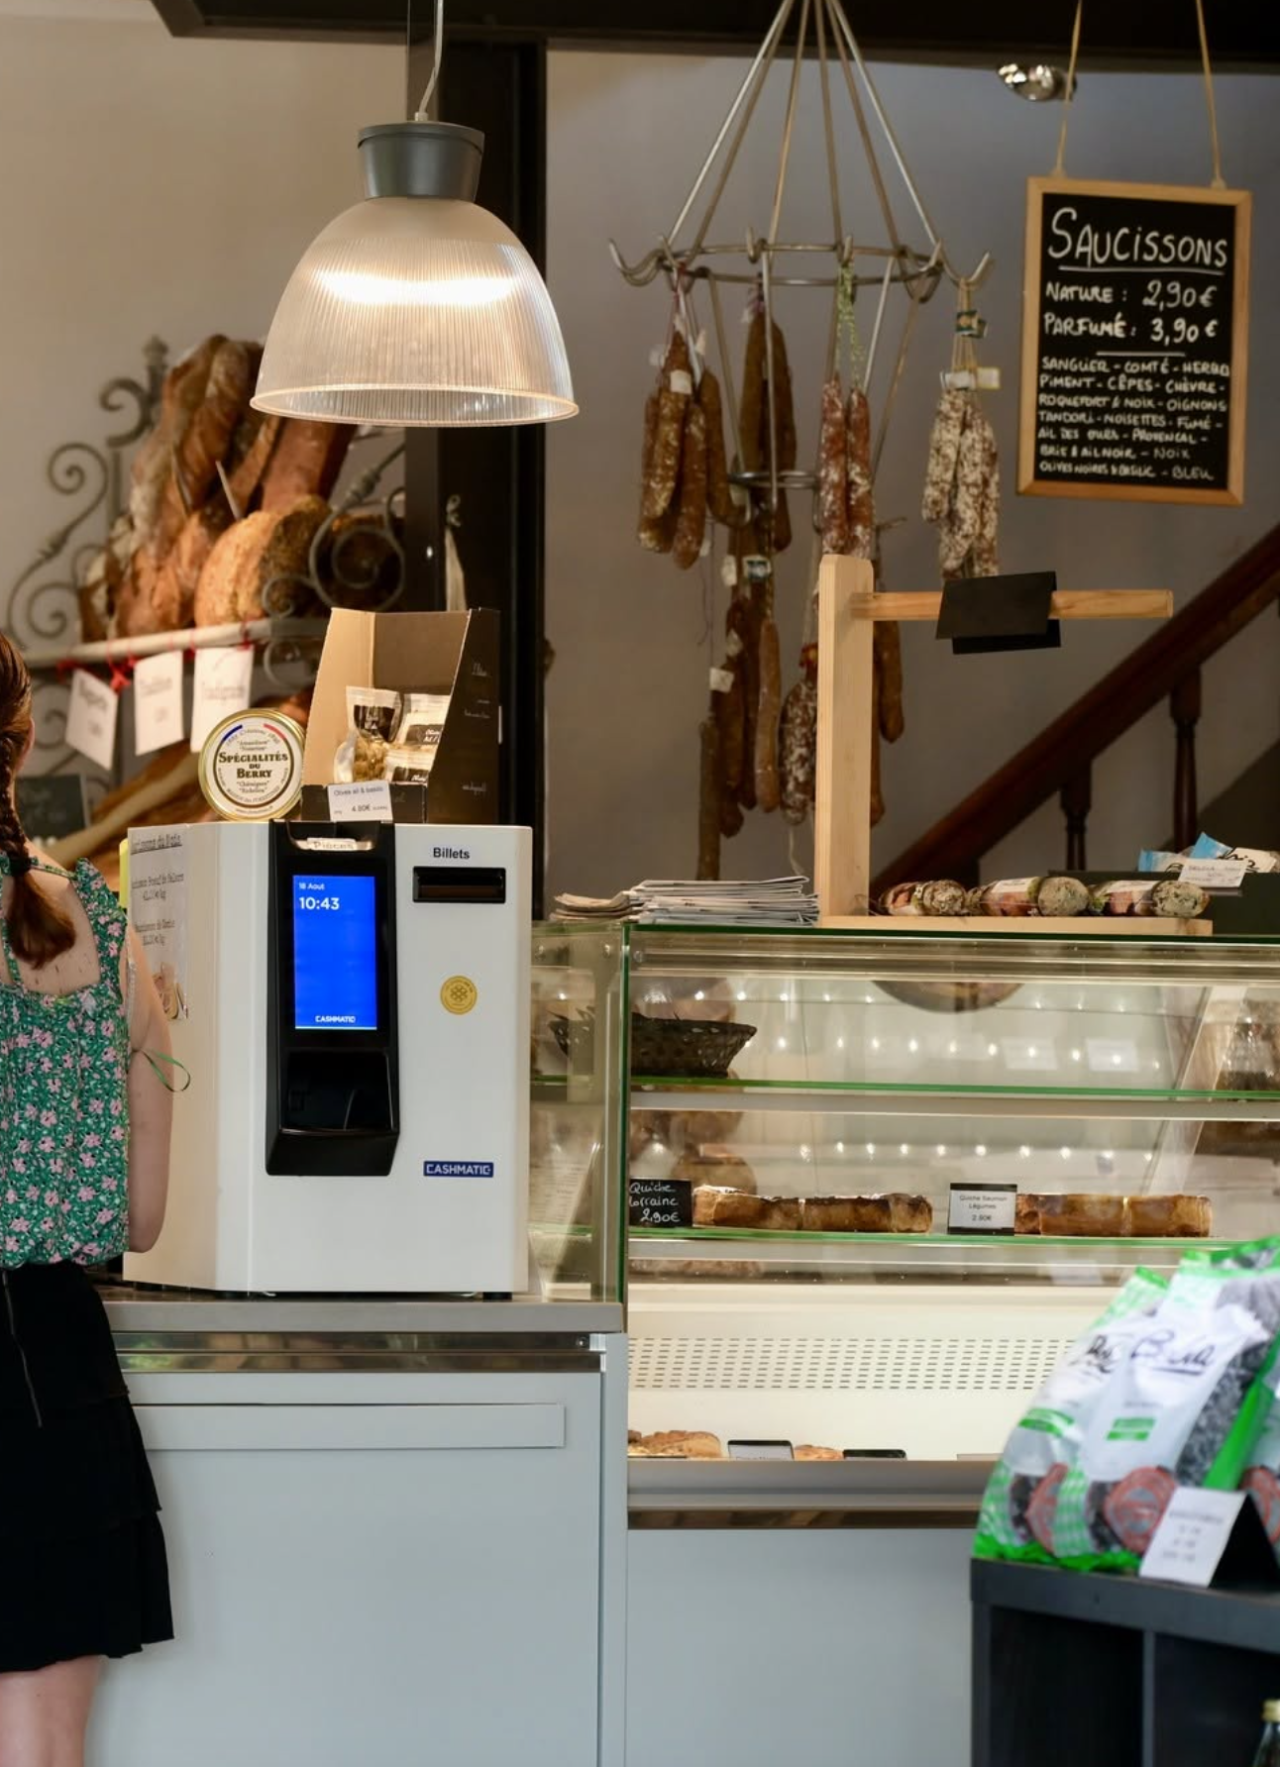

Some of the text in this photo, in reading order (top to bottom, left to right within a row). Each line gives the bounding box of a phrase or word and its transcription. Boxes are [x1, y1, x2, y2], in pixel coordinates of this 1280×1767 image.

[1046, 281, 1114, 303] NATURE
[1123, 357, 1170, 375] COMTÉ
[1039, 373, 1217, 394] PIMENT CÊPES CHÈVRE
[1039, 392, 1111, 409] ROQUEFORT
[1166, 397, 1228, 412] OIGNONS
[1103, 411, 1166, 428] NOISETTES
[1177, 414, 1212, 430] FUMÉ
[1153, 446, 1191, 459] NOIX
[218, 751, 288, 763] SPÉCIALITÉS
[236, 768, 272, 779] BERRY
[433, 846, 470, 859] Billets
[299, 897, 340, 911] 10:43
[315, 1015, 356, 1024] CASHMATIC
[426, 1163, 492, 1176] CASHMATIC
[629, 1181, 676, 1194] Quiche
[640, 1208, 681, 1223] 2,90€
